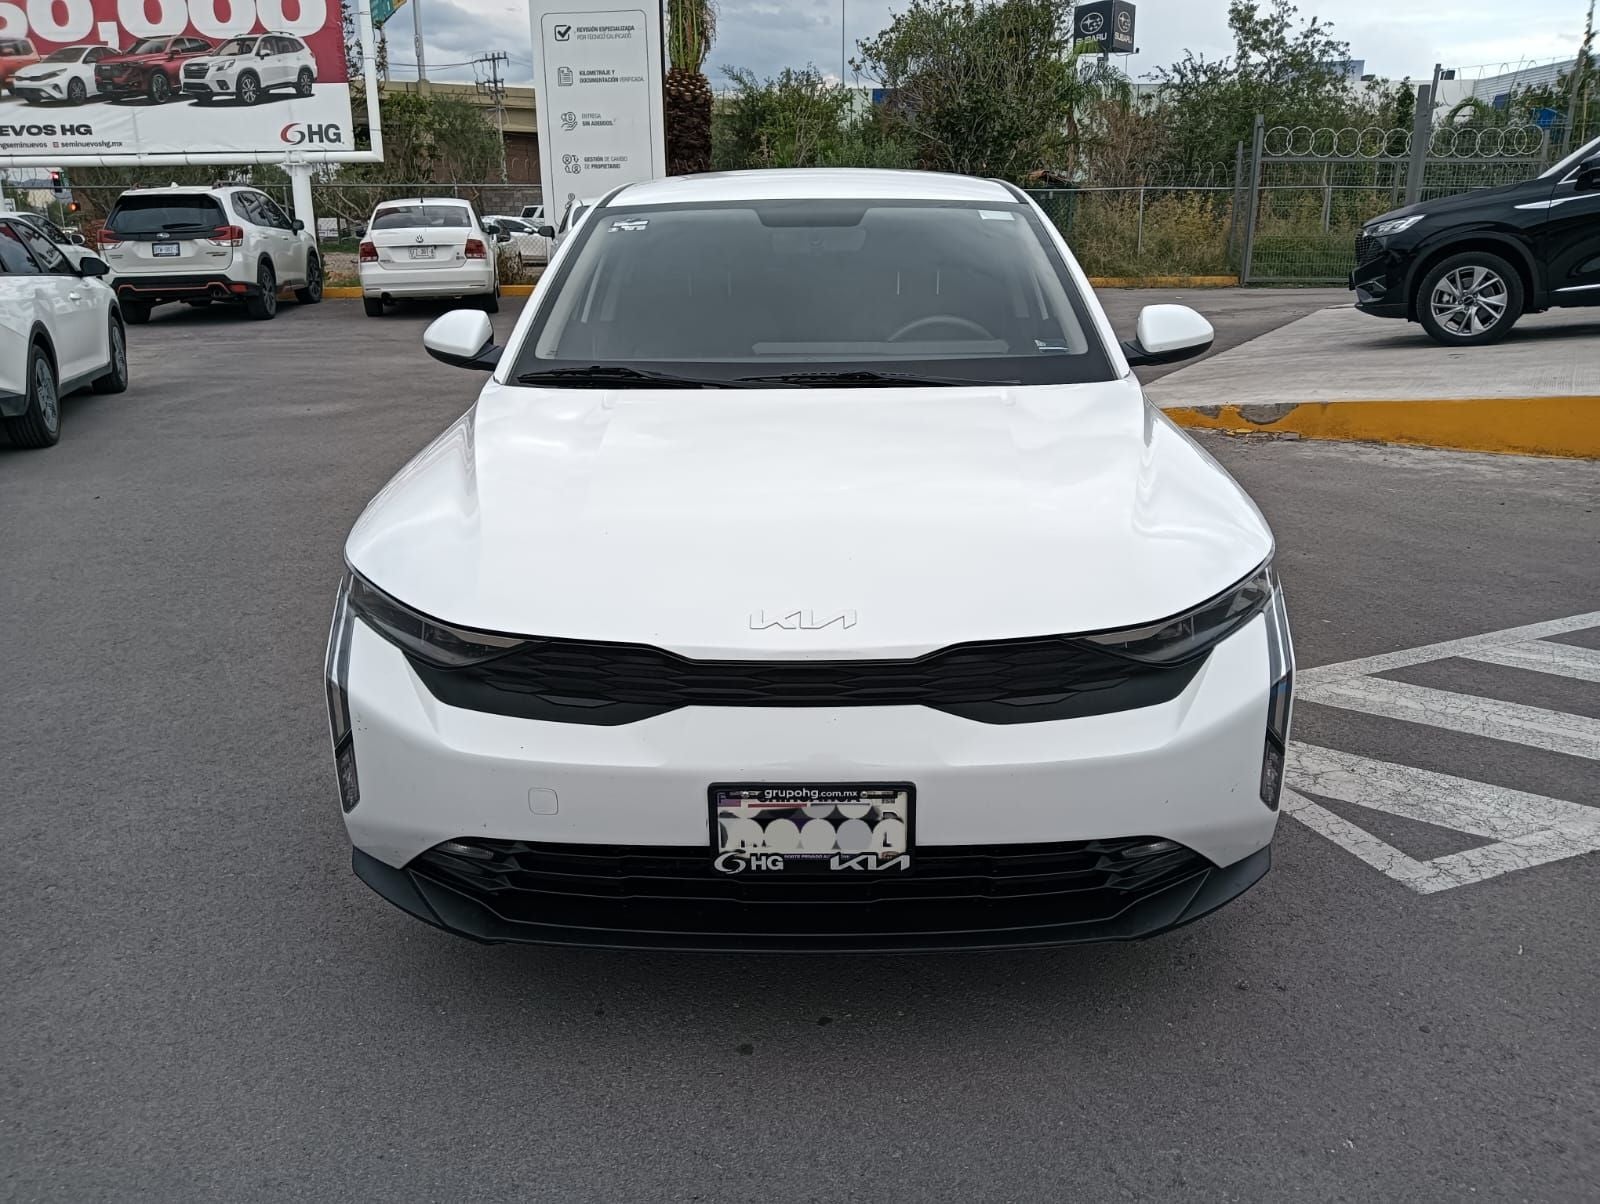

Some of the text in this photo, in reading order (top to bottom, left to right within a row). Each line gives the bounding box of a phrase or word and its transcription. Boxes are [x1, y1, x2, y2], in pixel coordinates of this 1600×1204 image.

[60, 124, 93, 136] HG
[307, 123, 342, 144] HG
[764, 788, 858, 799] grupohg.com.mx
[750, 856, 784, 871] HG
